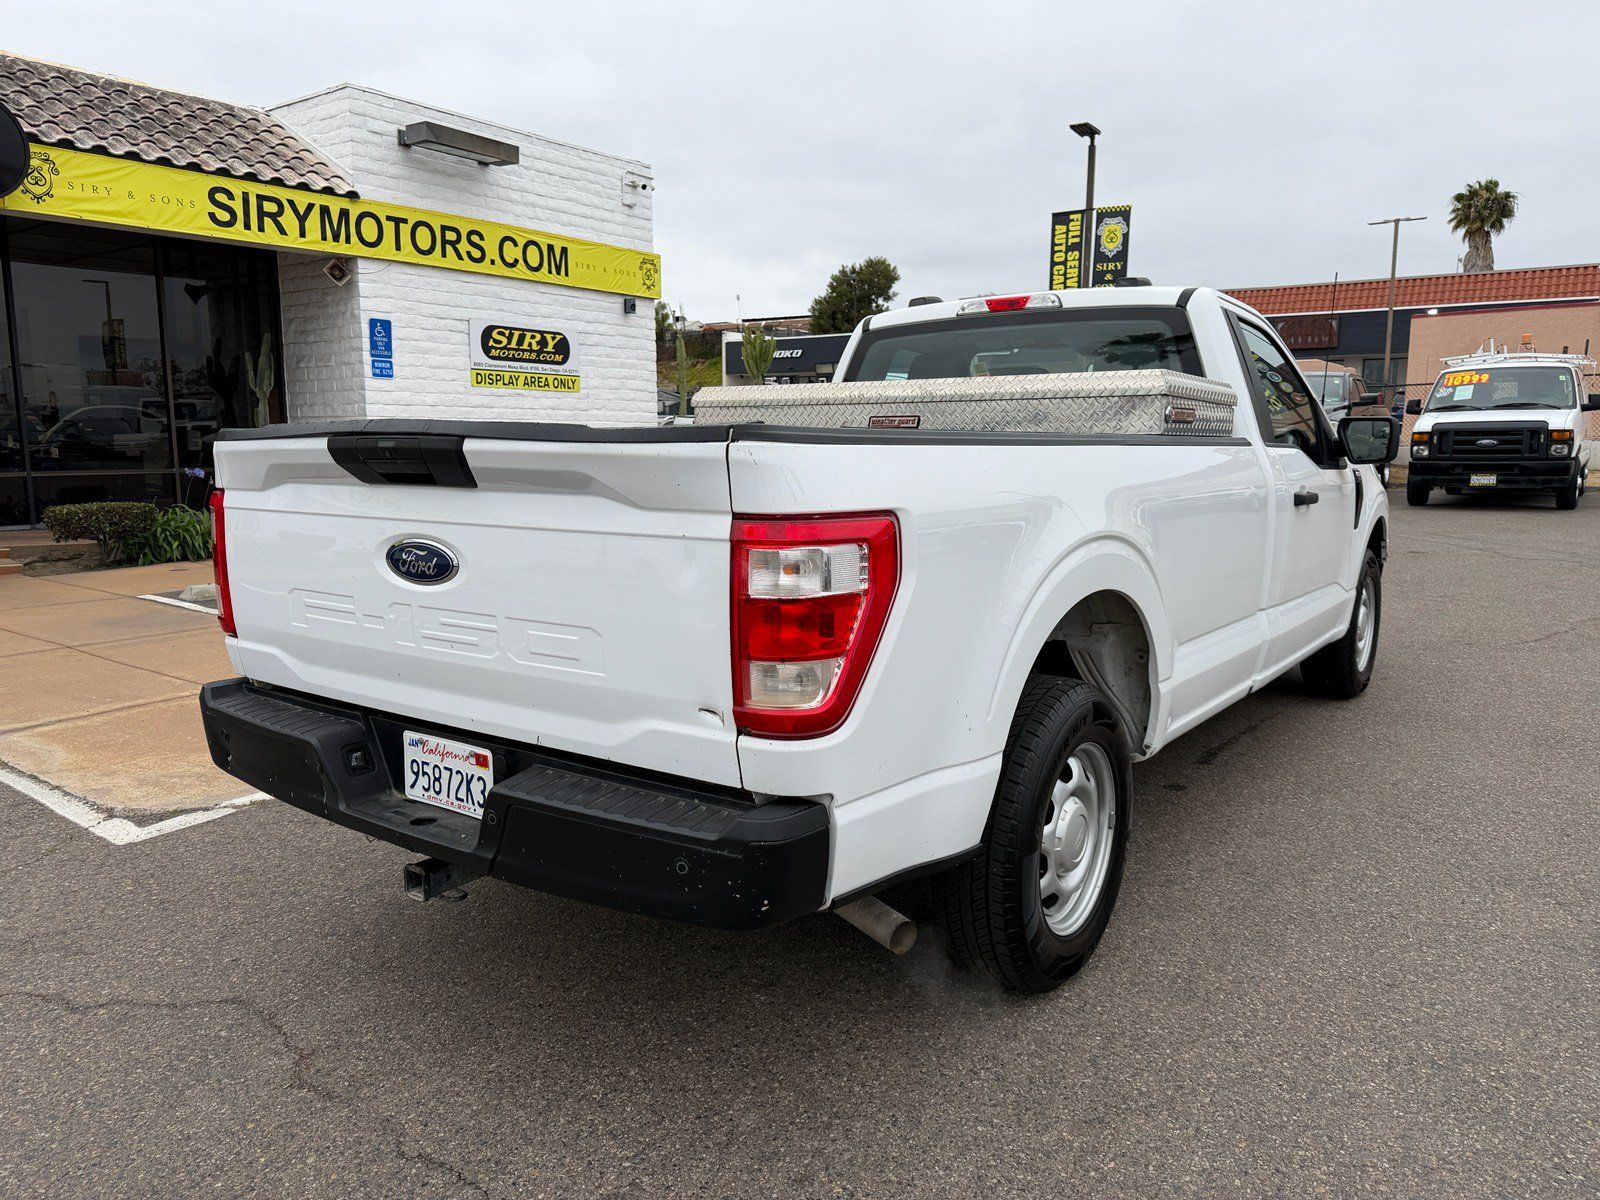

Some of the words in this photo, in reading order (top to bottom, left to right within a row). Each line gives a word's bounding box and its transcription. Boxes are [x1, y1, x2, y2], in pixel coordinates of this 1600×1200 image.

[67, 181, 113, 196] SIRY
[127, 190, 136, 200] &
[149, 193, 196, 208] SONS
[207, 186, 570, 277] SIRYMOTORS.COM
[1069, 213, 1082, 245] FULL
[1053, 225, 1067, 262] AUTO
[575, 261, 597, 271] SIRY
[613, 268, 637, 278] SONS
[1095, 262, 1124, 271] SIRY
[488, 328, 564, 352] SIRY
[489, 348, 564, 362] MOTORS.COM
[475, 372, 520, 386] DISPLAY
[523, 375, 550, 389] AREA
[552, 377, 577, 390] ONLY
[399, 547, 438, 576] Ford
[288, 587, 606, 677] F-150
[421, 739, 470, 763] California
[410, 758, 487, 809] 95872K3
[426, 794, 472, 810] dmv.ca.gov
